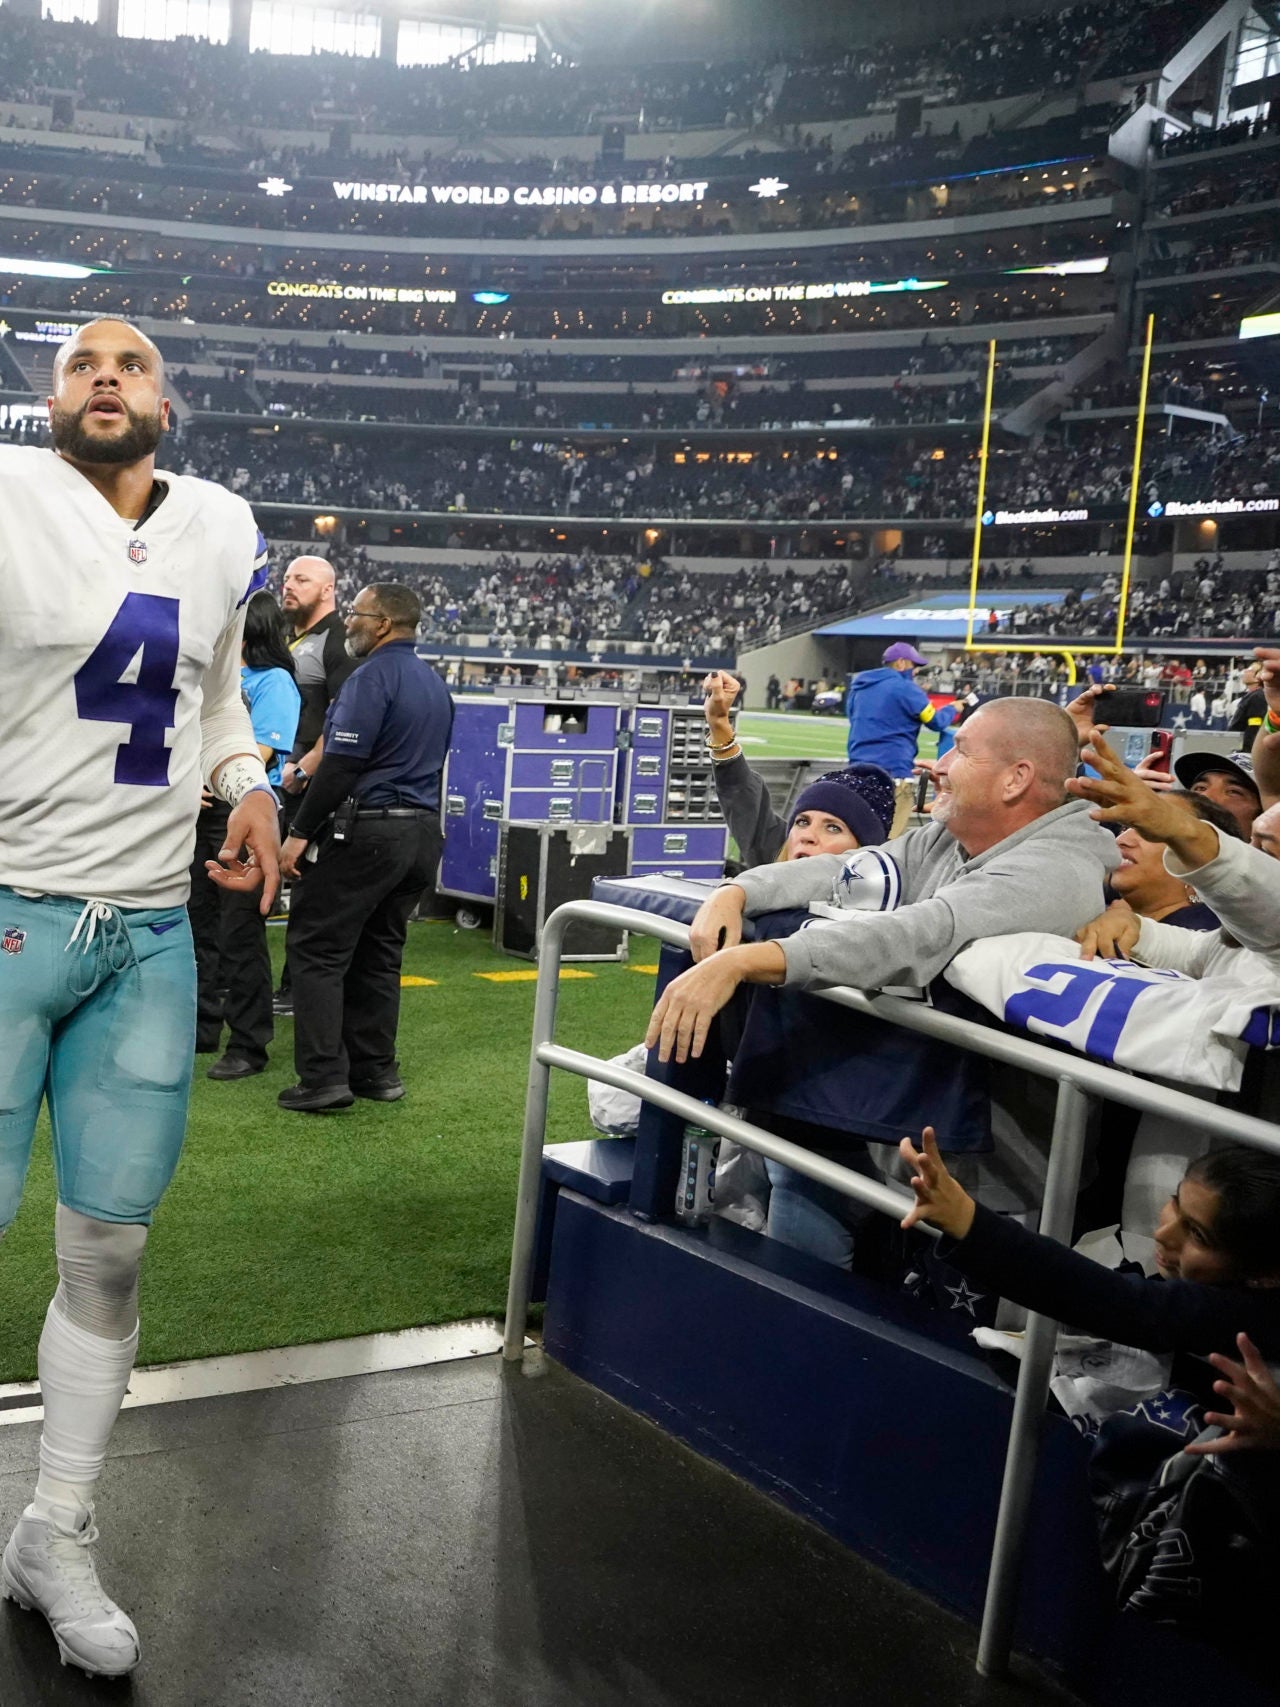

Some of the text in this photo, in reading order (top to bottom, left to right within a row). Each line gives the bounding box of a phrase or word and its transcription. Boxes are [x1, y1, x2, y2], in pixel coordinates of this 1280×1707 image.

[333, 181, 708, 205] WINSTAR WORLD CASINO & RESORT
[267, 282, 343, 299] CONGRATS
[344, 285, 368, 301] ON
[368, 286, 398, 302] THE
[425, 289, 457, 303] WIN
[745, 286, 771, 302] ON
[773, 285, 805, 301] THE
[35, 321, 84, 336] WINST
[1165, 497, 1280, 516] Blockchain.com
[995, 508, 1088, 525] Blockchain.com
[74, 592, 180, 786] 4
[4, 938, 21, 951] NFL
[1005, 962, 1161, 1063] 21
